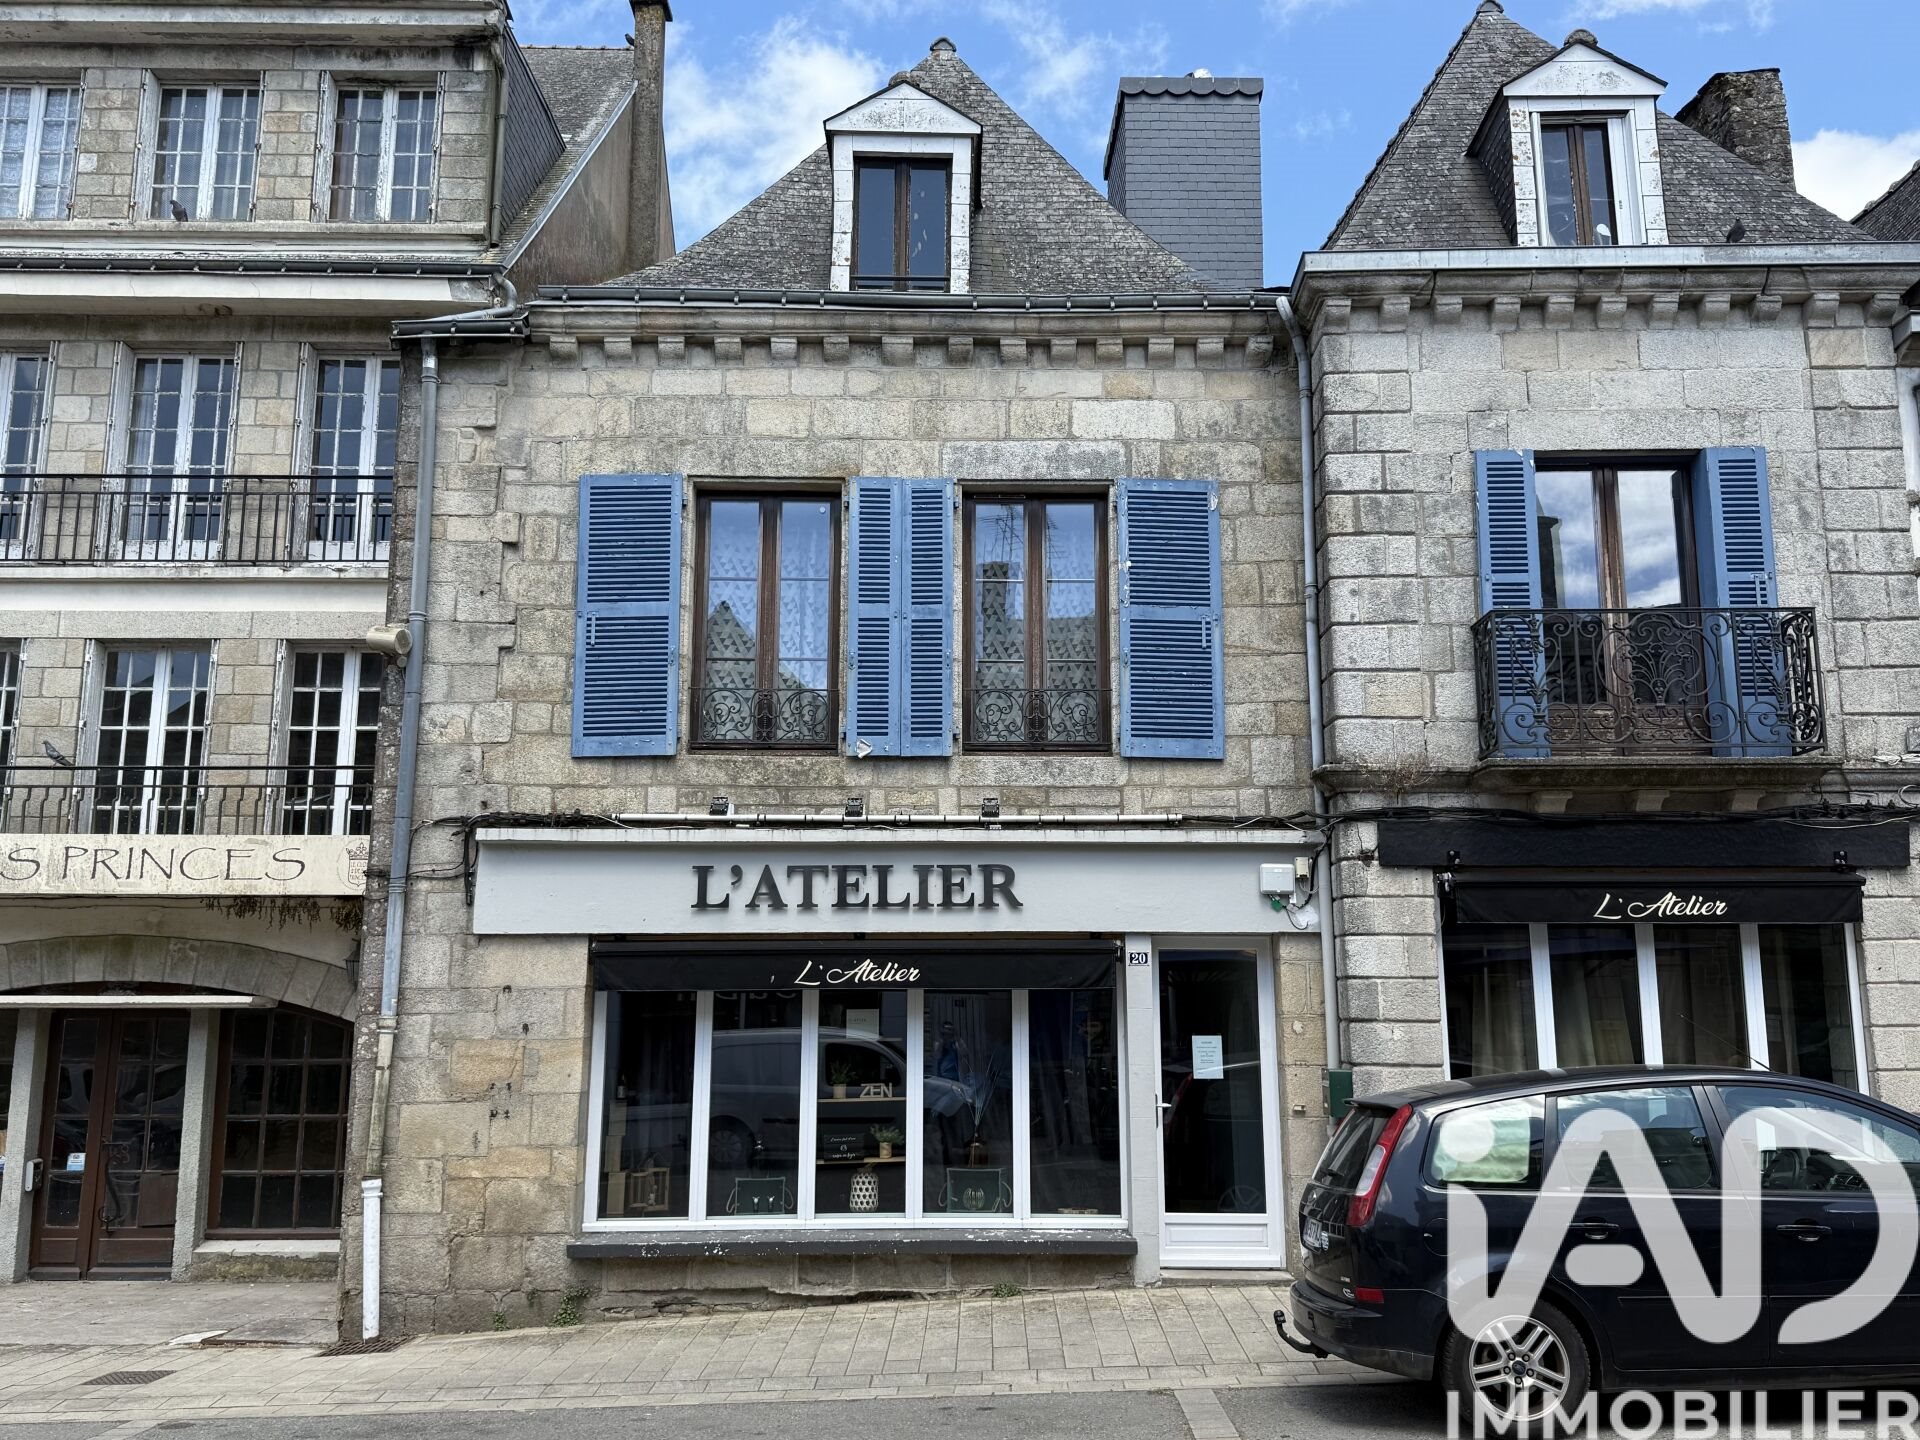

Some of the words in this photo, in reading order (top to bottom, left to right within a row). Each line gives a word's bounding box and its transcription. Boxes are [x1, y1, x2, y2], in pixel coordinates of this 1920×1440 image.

[62, 846, 306, 881] PRINCES
[690, 863, 1024, 910] L'ATELIER
[1131, 953, 1147, 964] 20
[859, 1082, 893, 1098] ZEN
